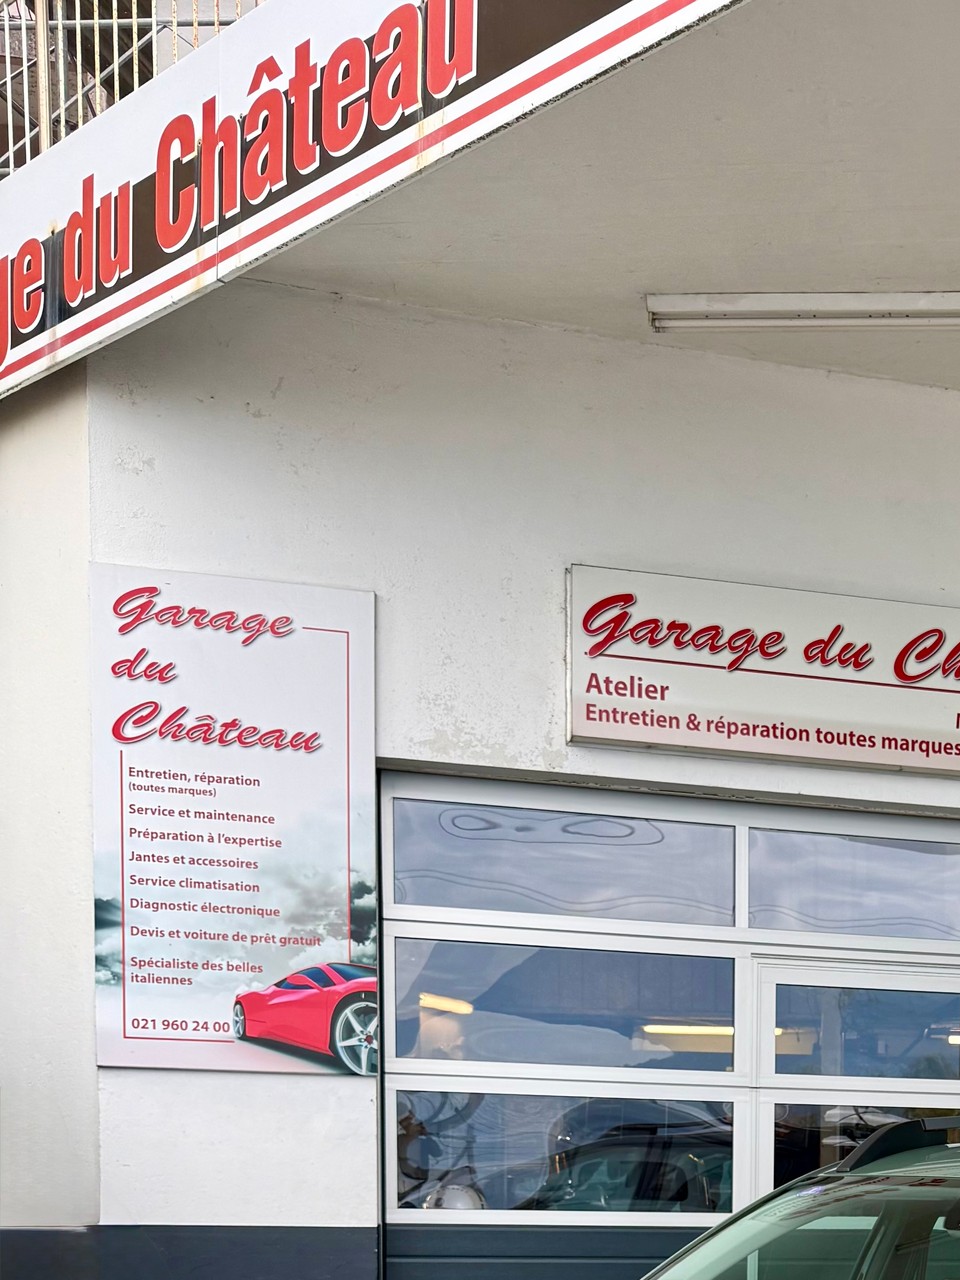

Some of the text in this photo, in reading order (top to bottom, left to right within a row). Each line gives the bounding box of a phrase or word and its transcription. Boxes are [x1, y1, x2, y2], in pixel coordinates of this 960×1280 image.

[63, 173, 132, 308] du
[155, 0, 480, 253] Château
[112, 586, 298, 646] Garage
[582, 593, 787, 671] Garage
[803, 623, 874, 671] du
[110, 647, 176, 684] du
[585, 672, 670, 701] Atelier
[112, 701, 323, 753] Château
[585, 703, 680, 730] Entretien
[686, 713, 701, 731] &
[706, 715, 810, 742] réparation
[816, 726, 876, 749] toutes
[128, 767, 261, 787] Entretien, réparation
[128, 782, 217, 798] (toutes marques)
[129, 804, 275, 824] Service et maintenance
[129, 828, 204, 842] Préparation
[207, 832, 215, 843] à
[128, 851, 259, 870] Jantes et accessoires
[129, 874, 260, 893] Service climatisation
[130, 898, 280, 919] Diagnostic électronique
[130, 926, 322, 947] Devis et voiture de prêt gratuit
[130, 956, 263, 973] Spécialiste des belles
[130, 972, 193, 985] italiennes
[131, 1018, 231, 1033] 021 960 24 00
